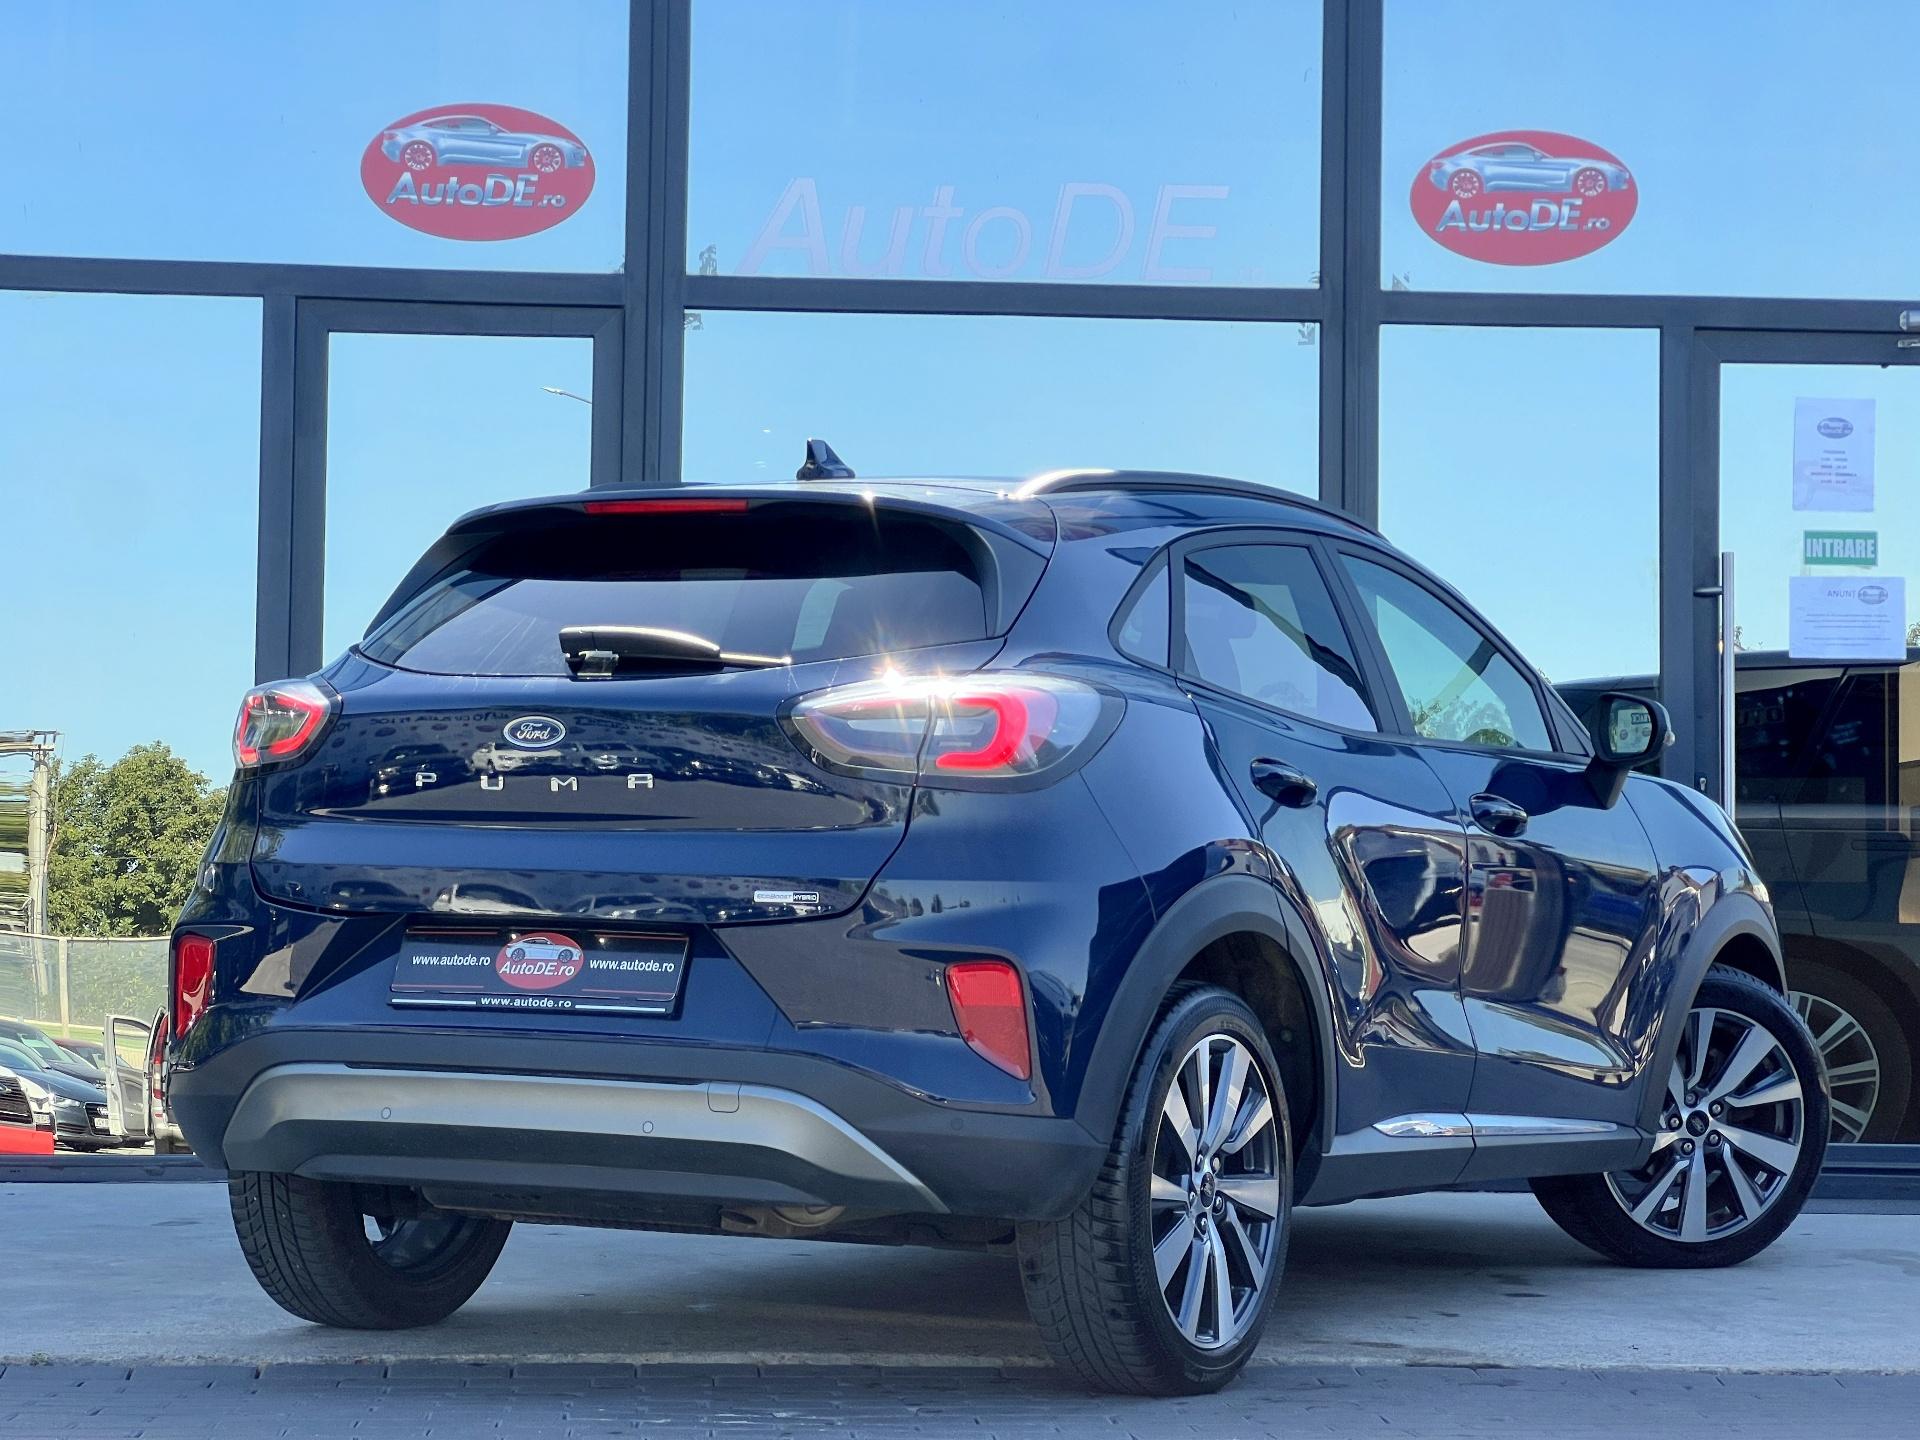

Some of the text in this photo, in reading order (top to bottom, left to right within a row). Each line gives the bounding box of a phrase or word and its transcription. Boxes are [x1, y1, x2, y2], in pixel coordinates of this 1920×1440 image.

[731, 176, 1231, 281] AutoDE
[1805, 538, 1876, 559] INTRARE
[516, 722, 552, 741] Ford
[415, 772, 654, 792] PUMA
[412, 953, 491, 967] www.autode.ro
[589, 959, 675, 973] www.autode.ro
[499, 961, 575, 977] AutoDE.ro
[480, 996, 572, 1009] www.autode.ro
